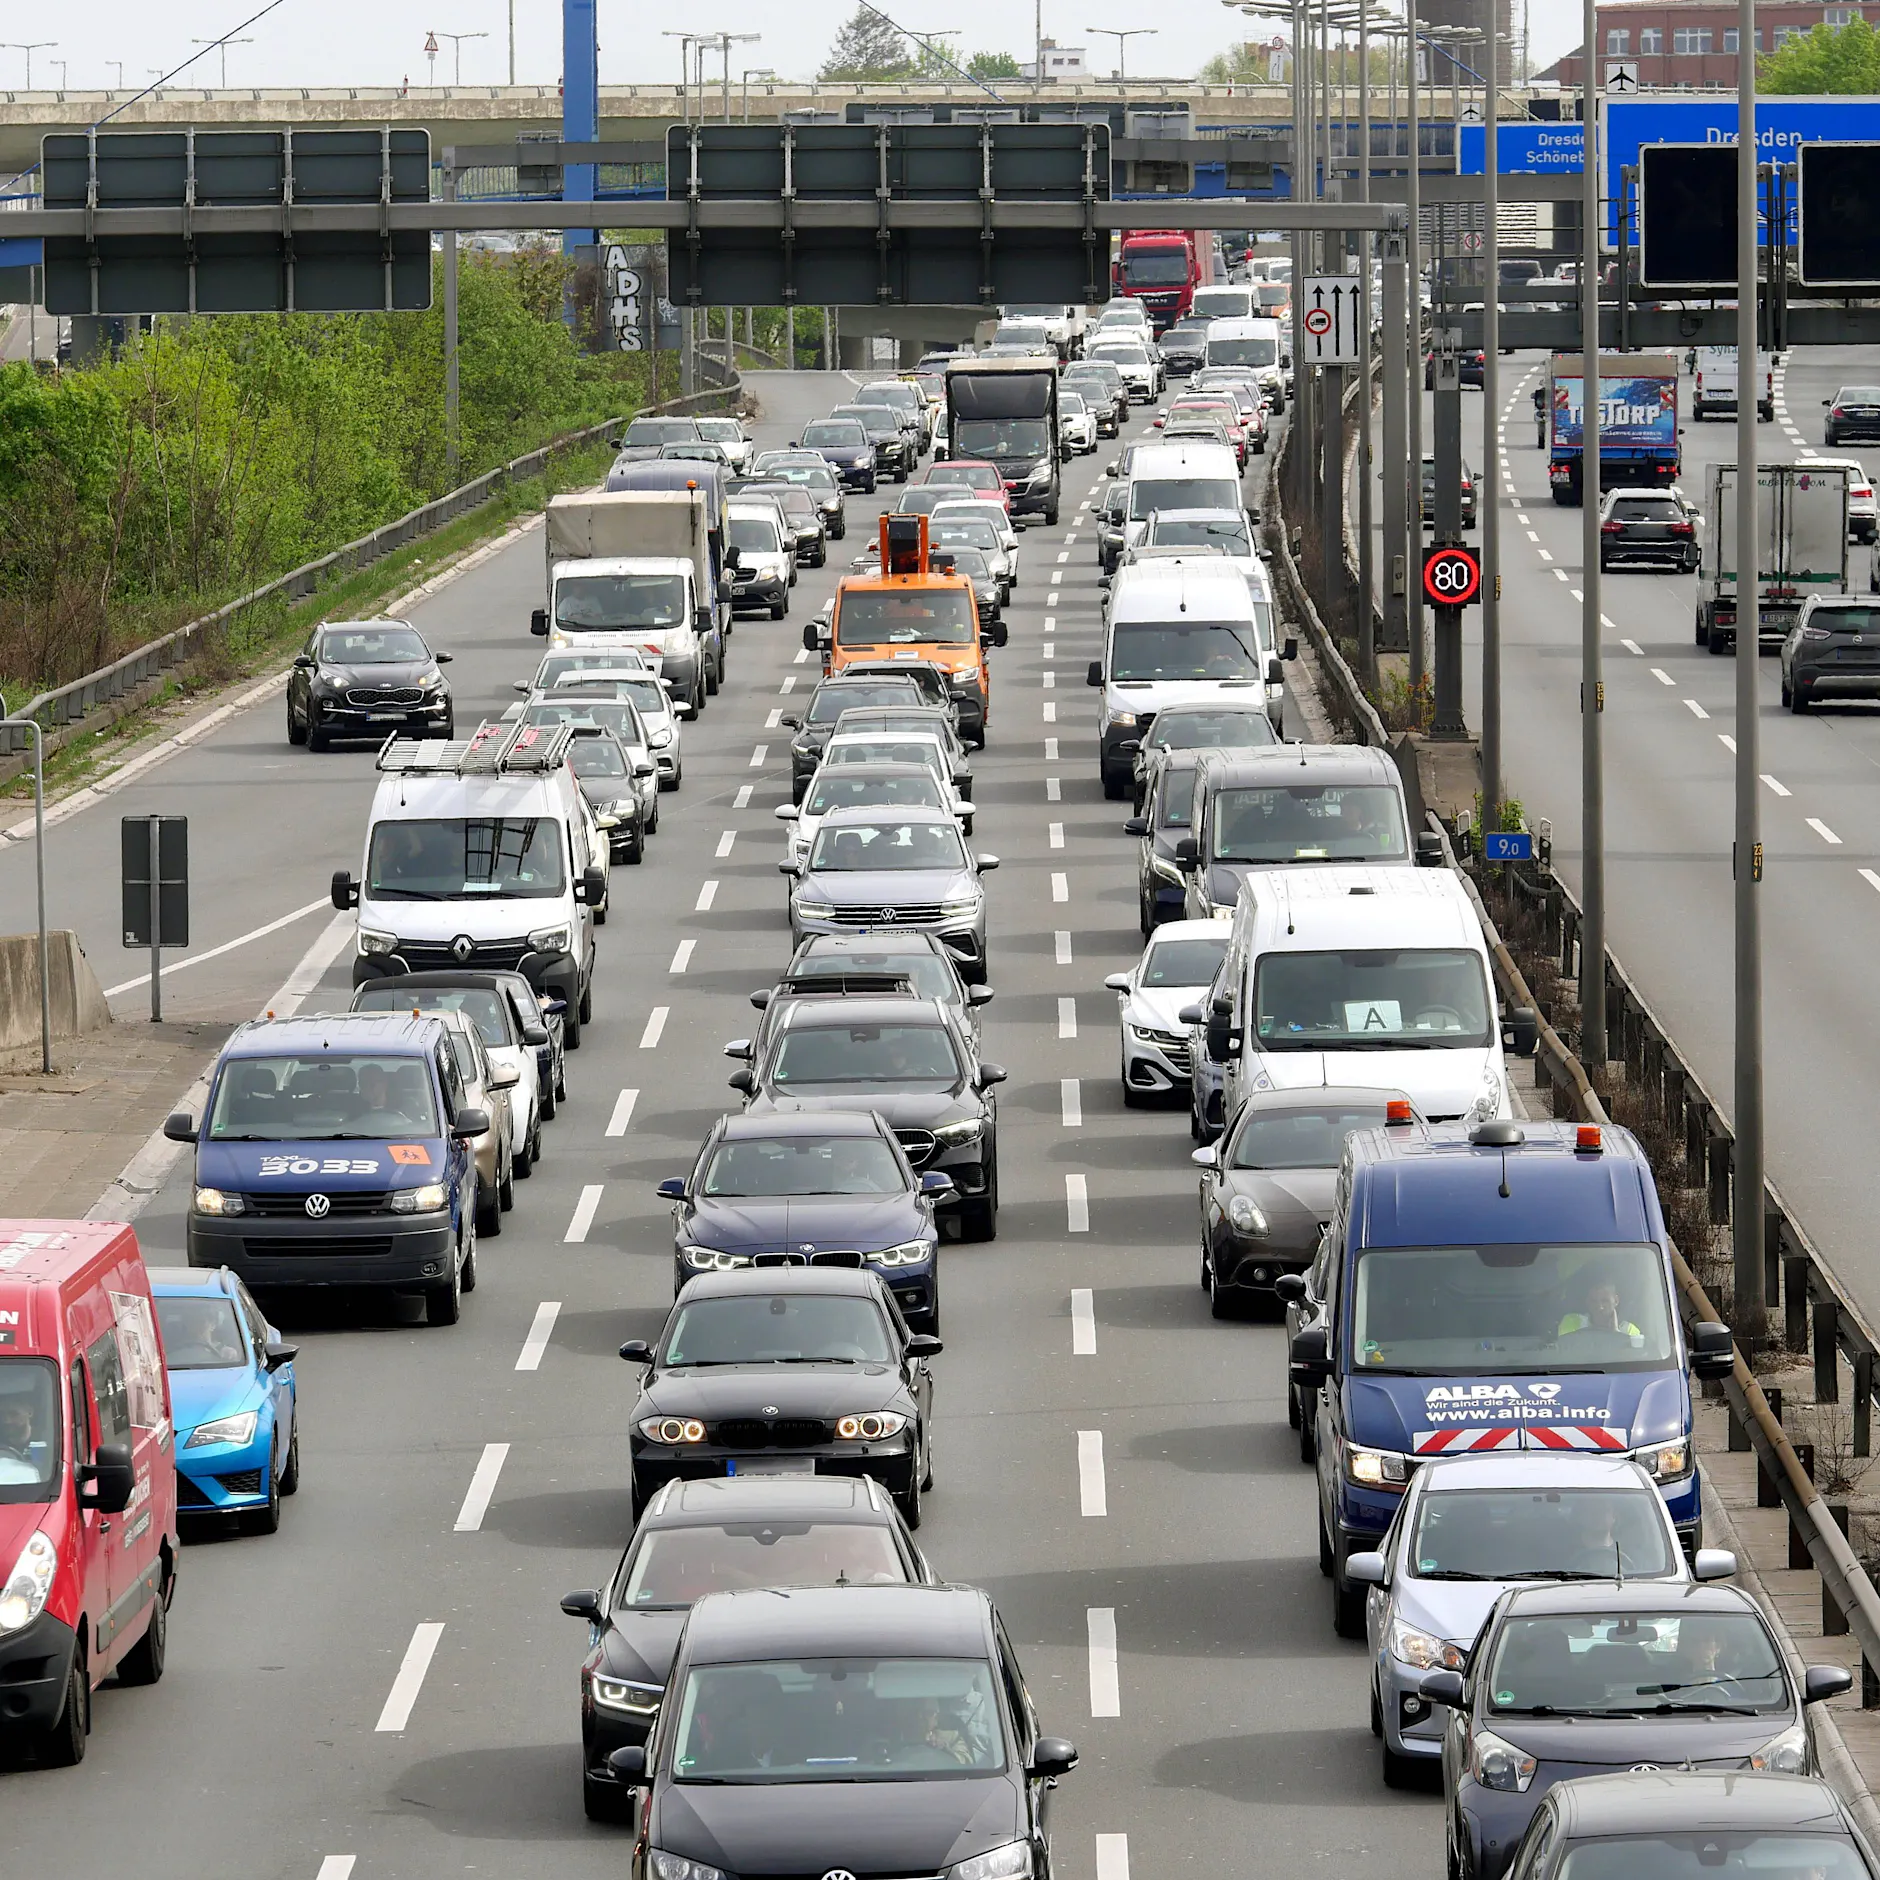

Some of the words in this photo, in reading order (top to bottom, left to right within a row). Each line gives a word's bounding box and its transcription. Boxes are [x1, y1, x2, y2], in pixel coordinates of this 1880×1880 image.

[605, 245, 643, 351] ADHS
[1435, 562, 1468, 590] 80
[1498, 839, 1519, 856] 9,0
[1363, 1007, 1387, 1030] A
[1425, 1384, 1521, 1402] ALBA
[1426, 1400, 1448, 1409] Wir
[1452, 1399, 1479, 1408] sind
[1483, 1399, 1504, 1407] die
[1507, 1398, 1561, 1407] Zukunft.
[1425, 1406, 1612, 1422] www.alba.info
